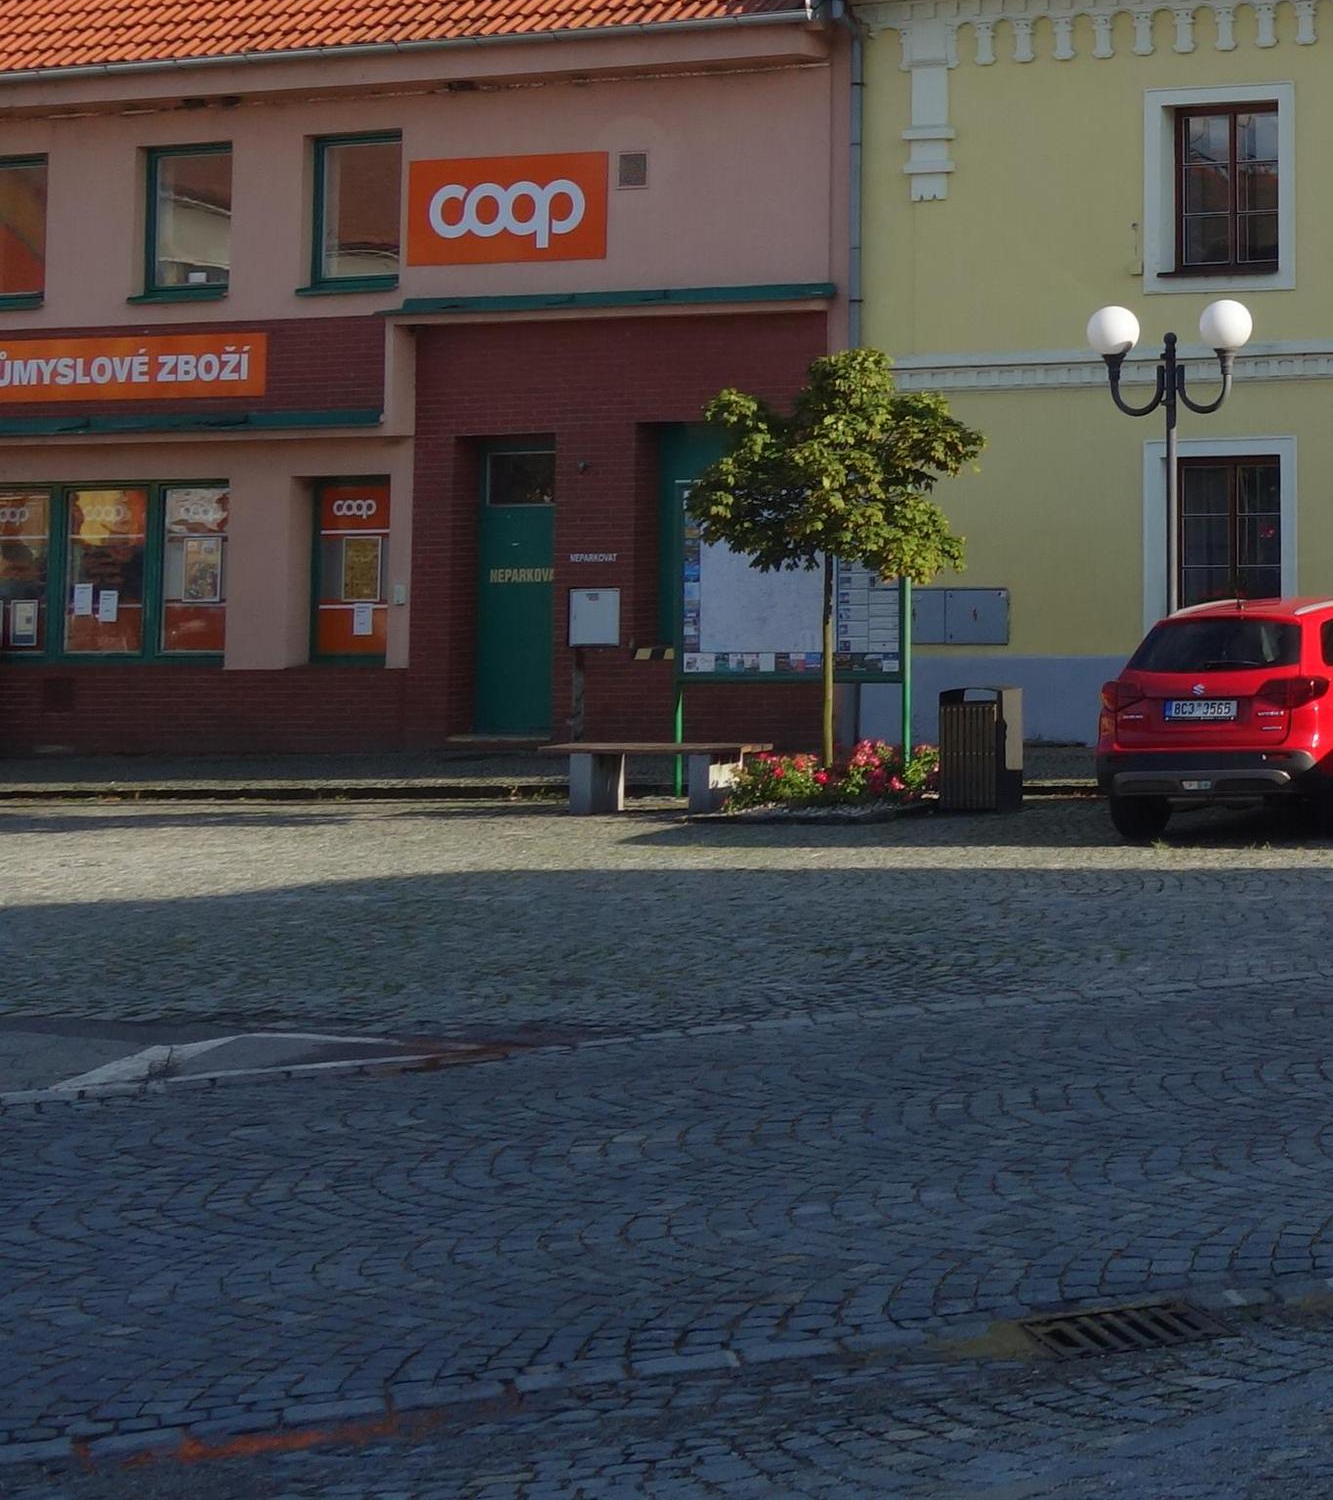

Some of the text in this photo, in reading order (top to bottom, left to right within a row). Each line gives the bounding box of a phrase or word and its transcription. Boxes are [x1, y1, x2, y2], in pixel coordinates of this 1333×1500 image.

[429, 178, 586, 249] coop
[157, 344, 252, 383] ZBOŽÍ
[333, 499, 377, 520] coop
[570, 553, 618, 563] NEPARKOVAT
[1174, 702, 1231, 715] 8C3 3565
